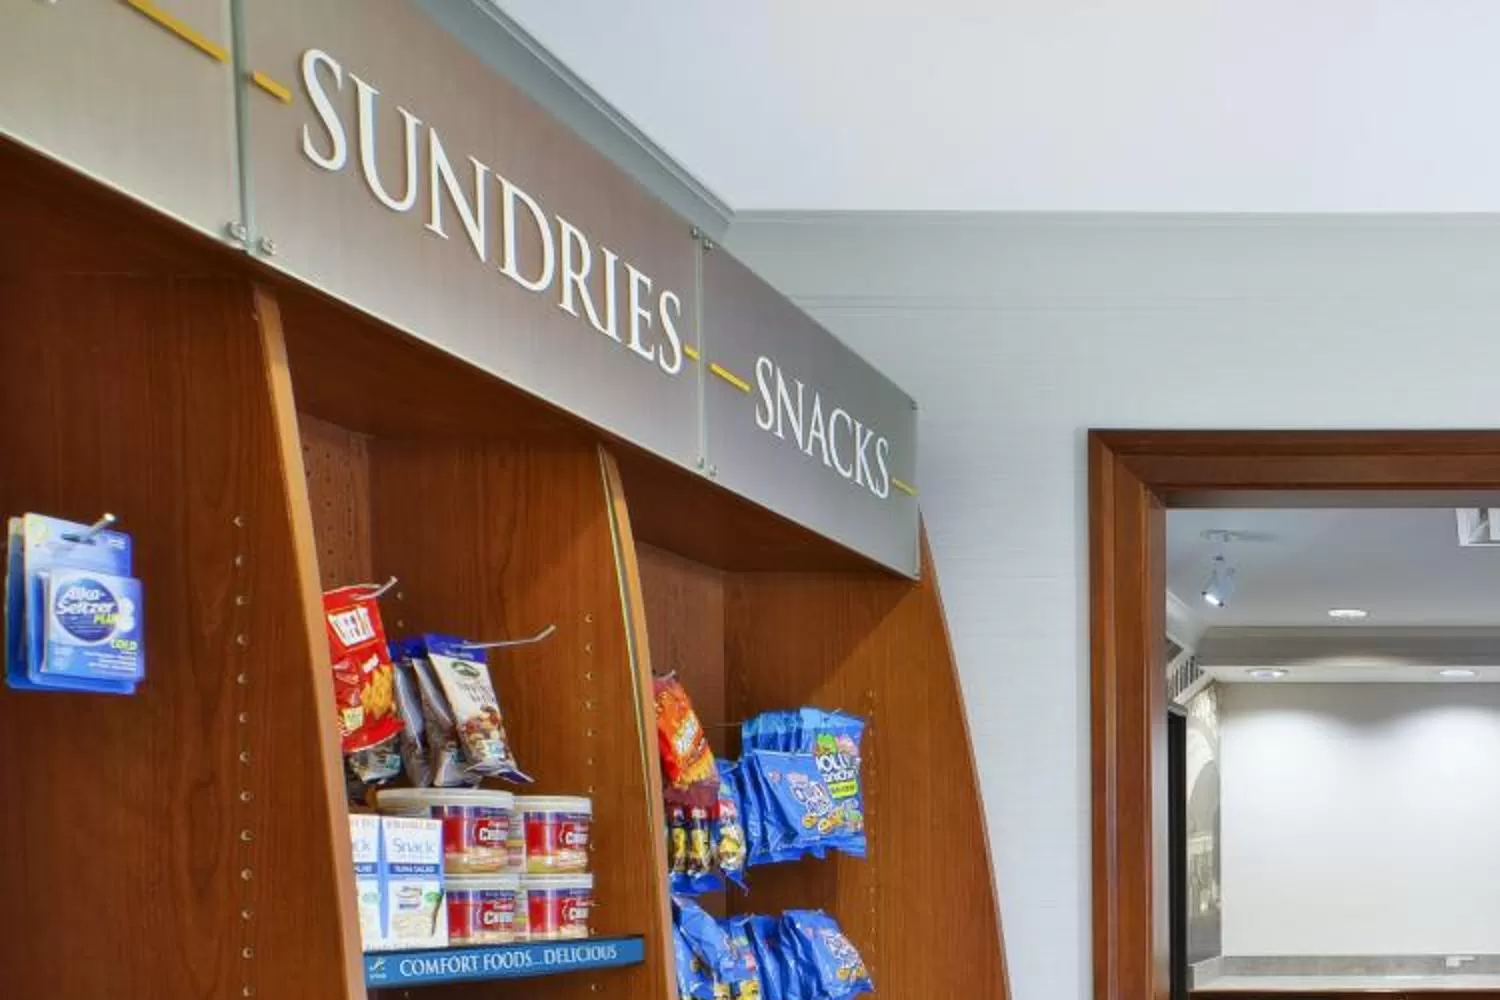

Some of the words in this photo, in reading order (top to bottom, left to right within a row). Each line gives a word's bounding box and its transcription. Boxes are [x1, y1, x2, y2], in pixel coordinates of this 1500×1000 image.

[301, 47, 684, 377] SUNDRIES
[755, 355, 890, 500] SNACKS
[399, 953, 480, 978] COMFORT
